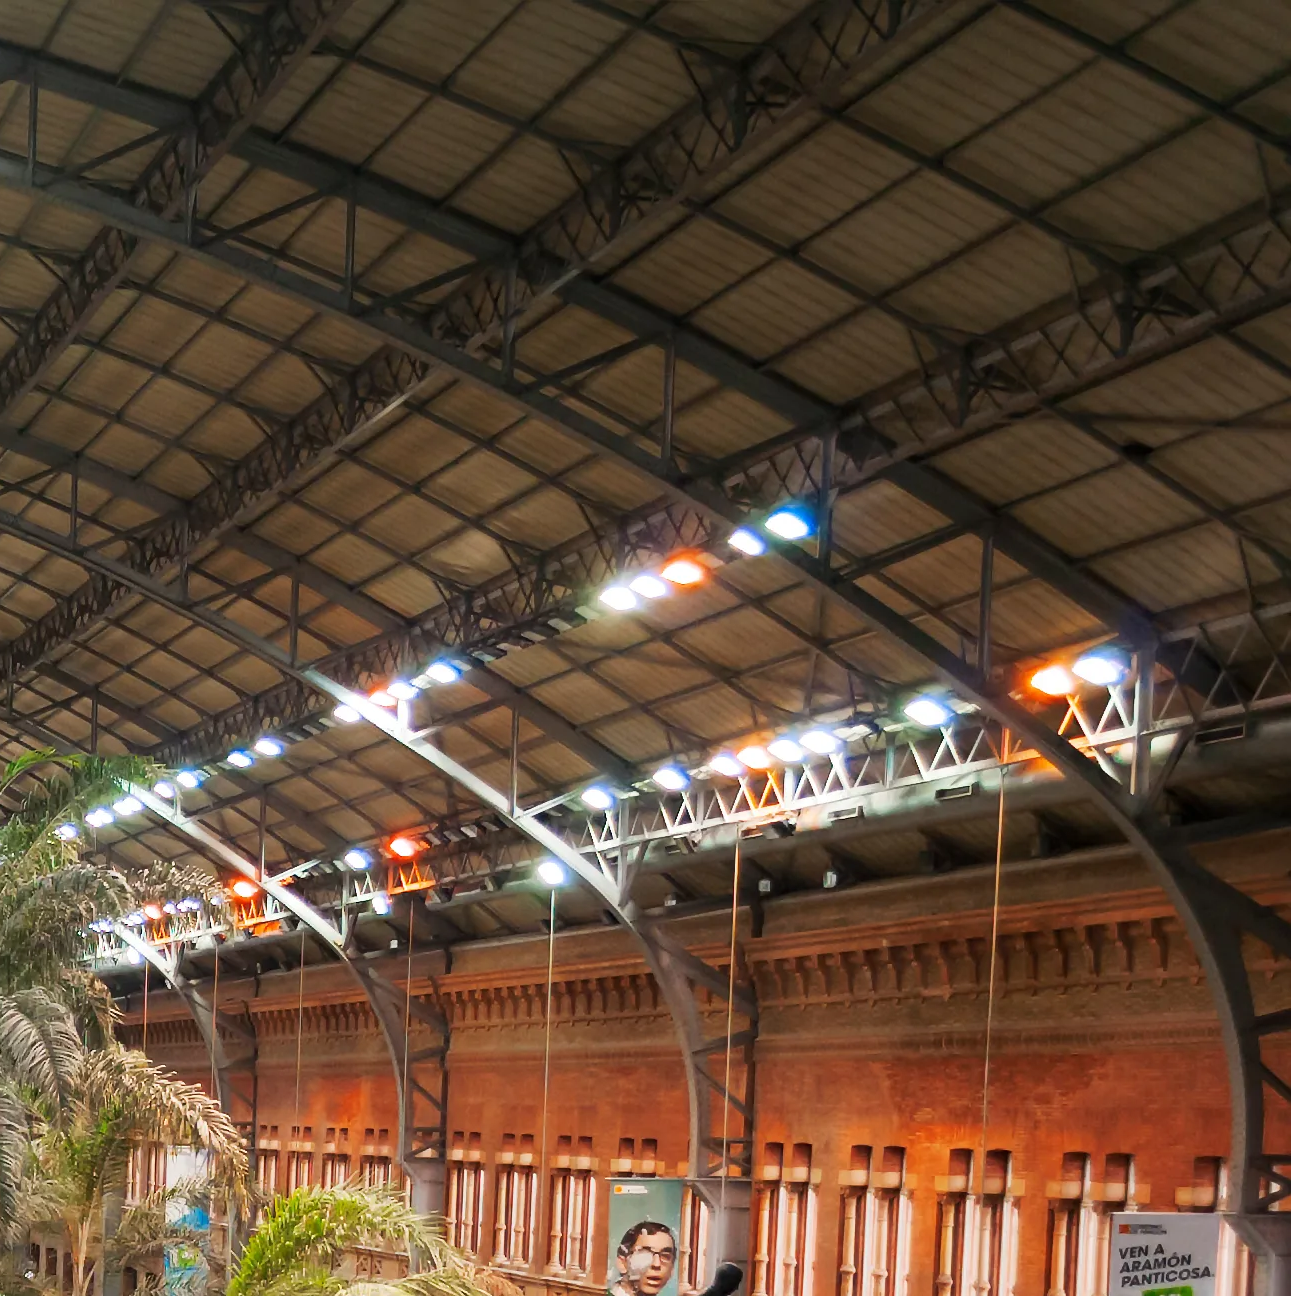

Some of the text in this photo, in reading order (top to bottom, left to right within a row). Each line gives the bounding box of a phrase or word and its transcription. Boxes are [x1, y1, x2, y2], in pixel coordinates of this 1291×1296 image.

[1119, 1244, 1165, 1260] VEN A
[1120, 1252, 1192, 1273] ARAMÓN
[1121, 1266, 1215, 1287] PANTICOSA.
